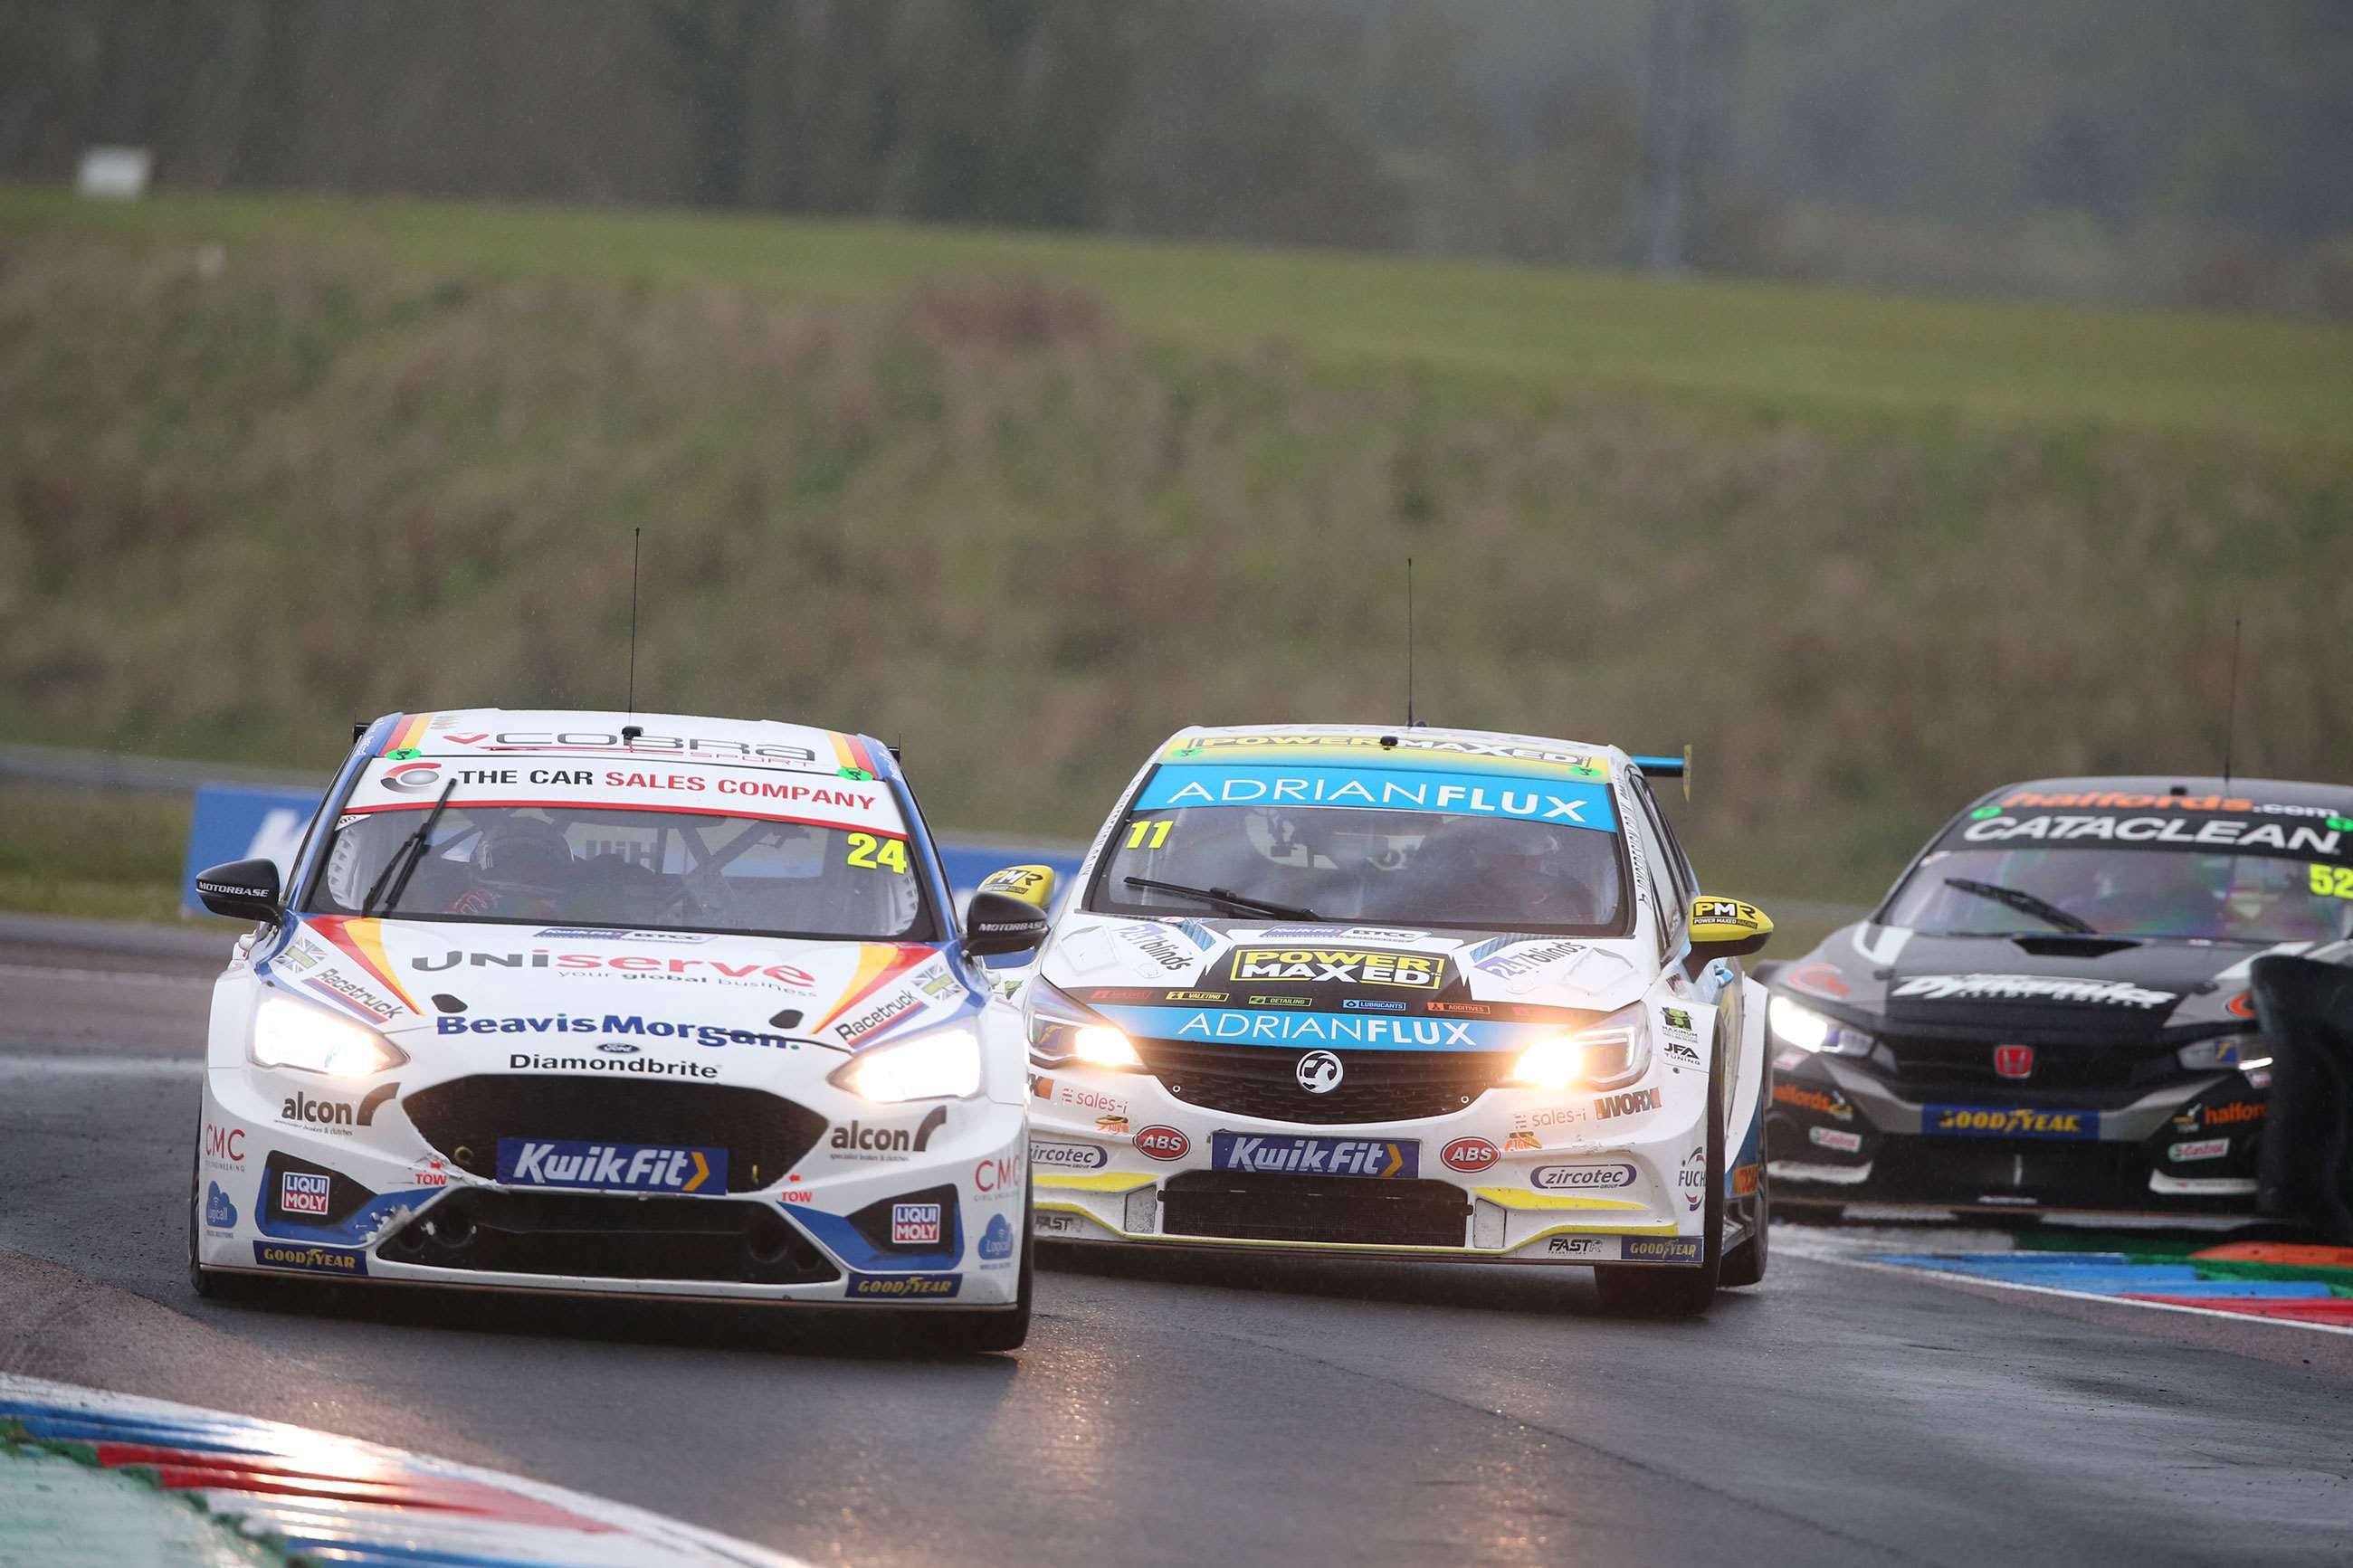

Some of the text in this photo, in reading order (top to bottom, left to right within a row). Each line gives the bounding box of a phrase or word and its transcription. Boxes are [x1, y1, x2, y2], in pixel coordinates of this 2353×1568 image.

[458, 770, 877, 811] THE CAR SALES COMPANY
[1126, 820, 1174, 850] 11
[1963, 816, 2342, 855] CATACLEAN
[846, 832, 908, 875] 24
[197, 881, 271, 898] MOTORBASE
[2309, 862, 2353, 900] 52
[1243, 951, 1432, 974] POWER
[622, 973, 708, 984] global
[315, 967, 405, 1020] Racetruck
[1270, 996, 1306, 1005] DETAILING
[834, 989, 919, 1042] Racetruck
[1359, 1001, 1404, 1011] LUBRICANTS
[1448, 1003, 1485, 1012] ADDITIVES
[1663, 1041, 1700, 1060] JFA
[510, 1053, 719, 1079] Diamondbrite
[281, 1091, 353, 1126] alcon
[1076, 1092, 1129, 1114] sales-i
[205, 1124, 246, 1162] CMC
[830, 1120, 910, 1152] alcon
[1143, 1135, 1182, 1153] ABS
[1031, 1145, 1095, 1164] ircotec
[1451, 1146, 1492, 1164] ABS
[287, 1175, 327, 1193] LIQUI
[415, 1174, 448, 1185] TOW
[1545, 1169, 1624, 1184] zircotec
[1679, 1171, 1707, 1187] FUCH
[285, 1193, 327, 1212] MOLY
[897, 1207, 937, 1222] LIQUI
[897, 1223, 938, 1240] MOLY
[263, 1248, 356, 1269] GOODYEAR
[1629, 1240, 1697, 1259] GOODYEAR
[857, 1276, 952, 1295] GOODYEAR
